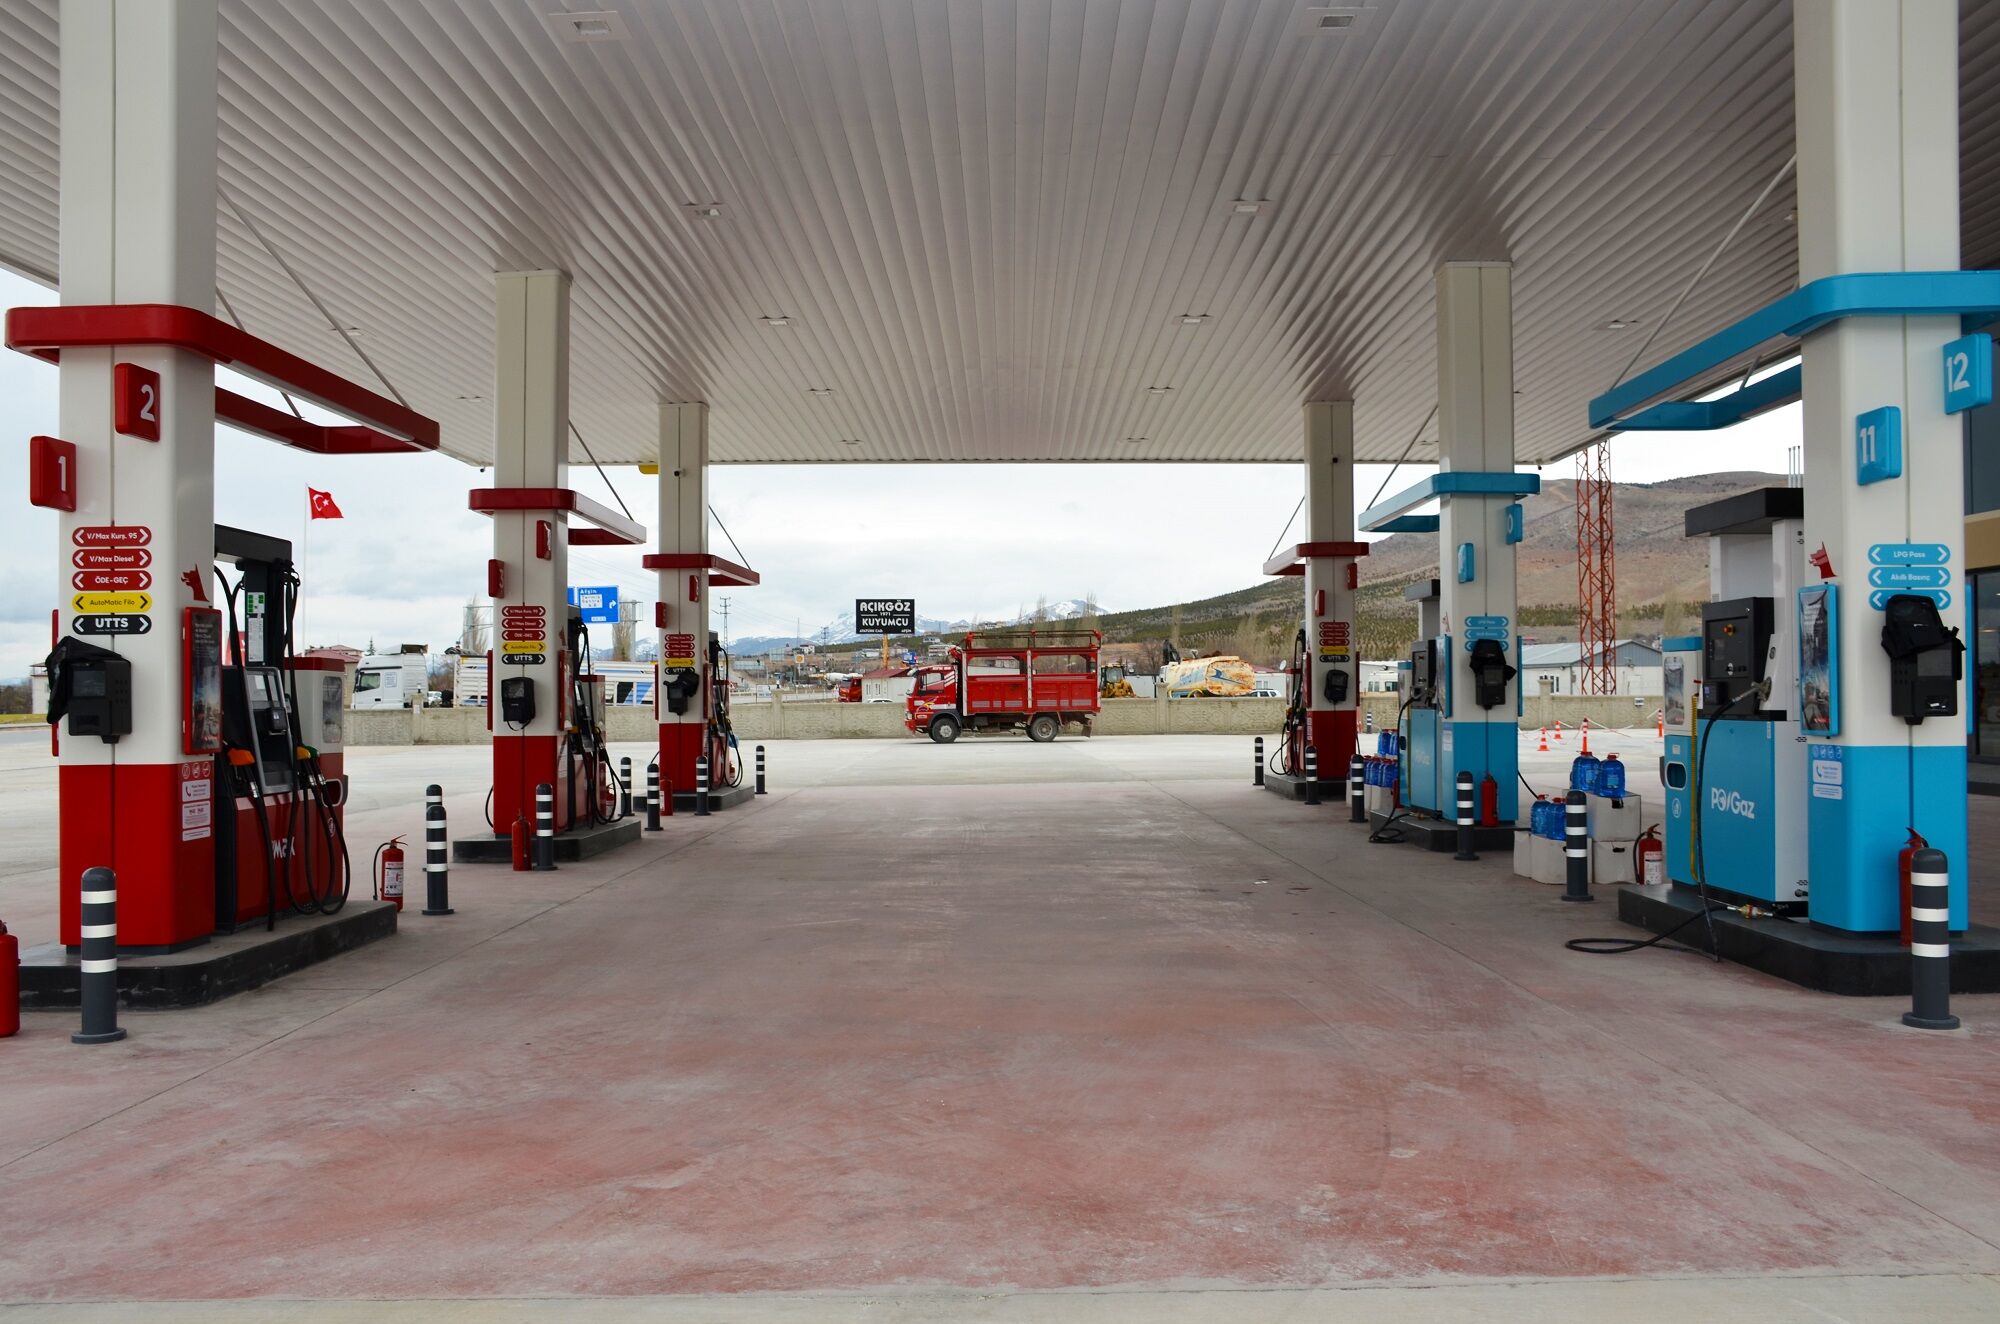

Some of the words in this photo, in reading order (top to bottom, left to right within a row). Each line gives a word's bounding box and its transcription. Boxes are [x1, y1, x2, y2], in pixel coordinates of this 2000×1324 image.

[1946, 352, 1970, 392] 12
[140, 384, 155, 422] 2
[1860, 425, 1875, 463] 11
[58, 455, 66, 491] 1
[87, 532, 110, 540] V/Max
[860, 600, 911, 613] AÇIKGÖZ
[95, 617, 129, 628] UTTS
[862, 618, 909, 626] KUYUMCU
